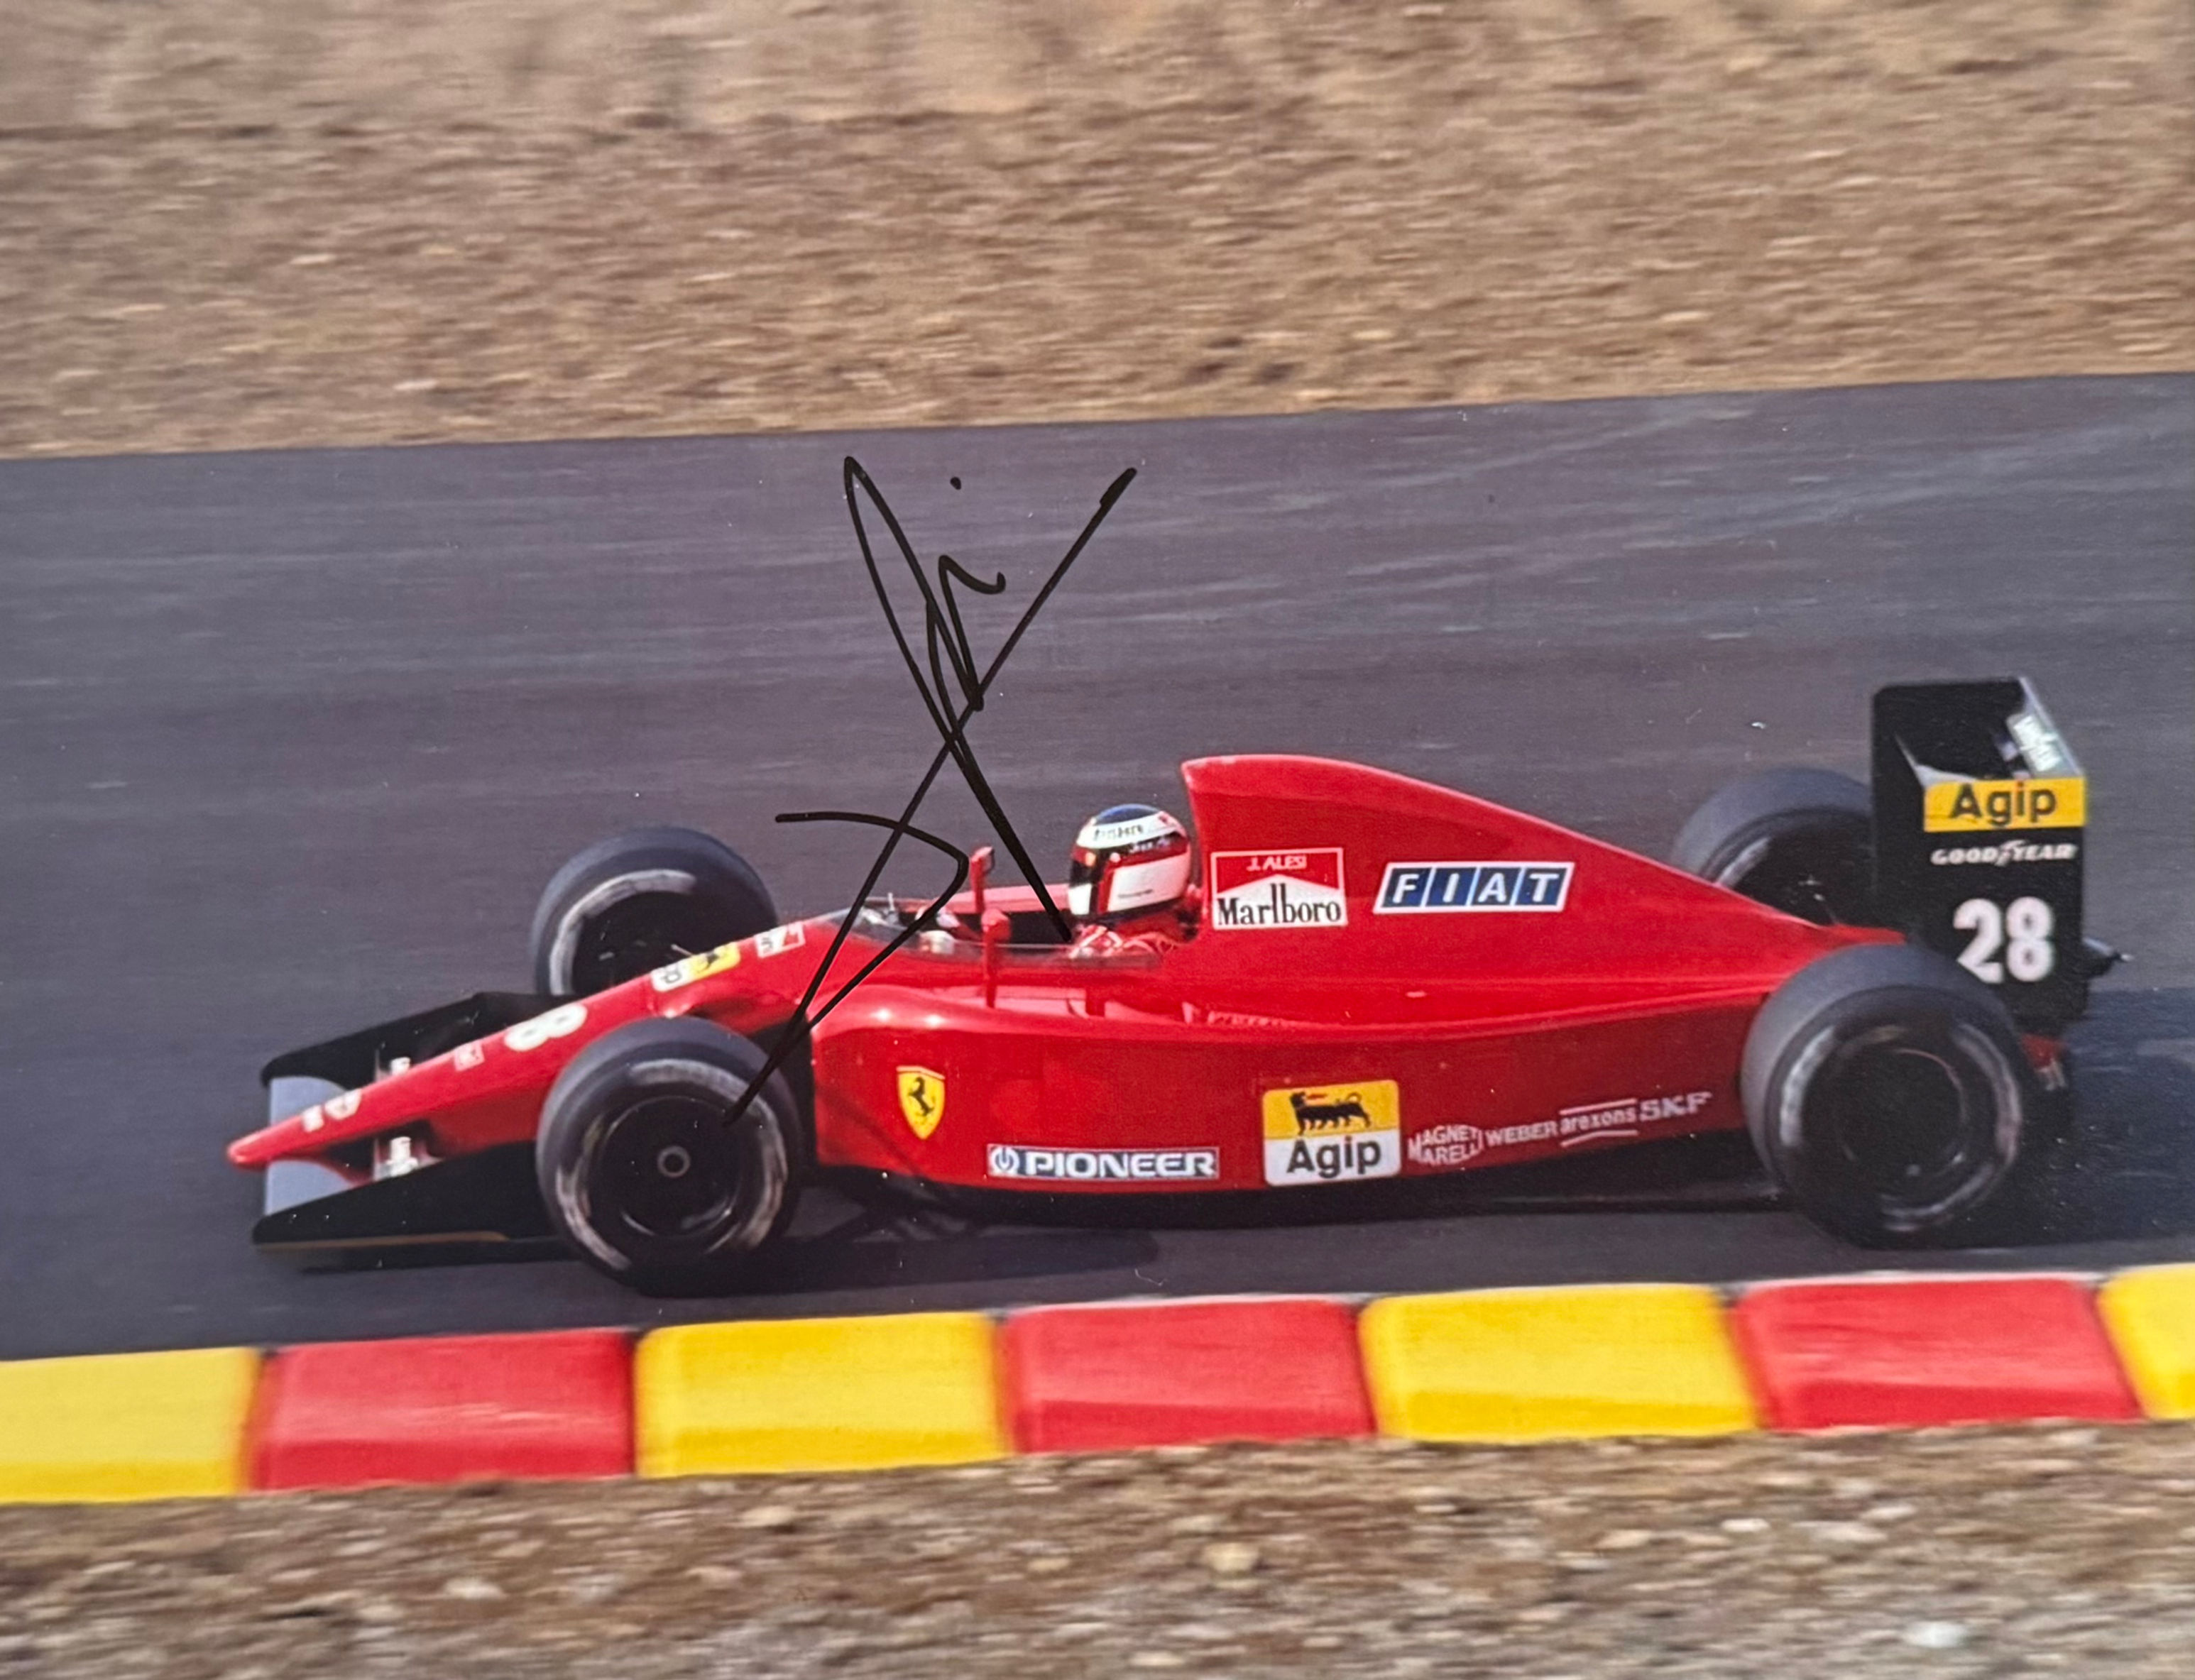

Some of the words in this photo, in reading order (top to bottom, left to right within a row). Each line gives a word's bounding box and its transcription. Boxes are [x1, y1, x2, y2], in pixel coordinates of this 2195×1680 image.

[1951, 782, 2057, 825] Agip
[1930, 840, 2077, 867] GOODYEAR
[1217, 882, 1342, 926] Marlboro
[1392, 872, 1560, 905] FIAT
[1953, 896, 2054, 984] 28
[1560, 1107, 1636, 1134] arexons
[1639, 1091, 1713, 1122] SKF
[1486, 1119, 1559, 1148] WEBER
[1025, 1149, 1217, 1179] PIONEER
[1287, 1137, 1381, 1180] Agip
